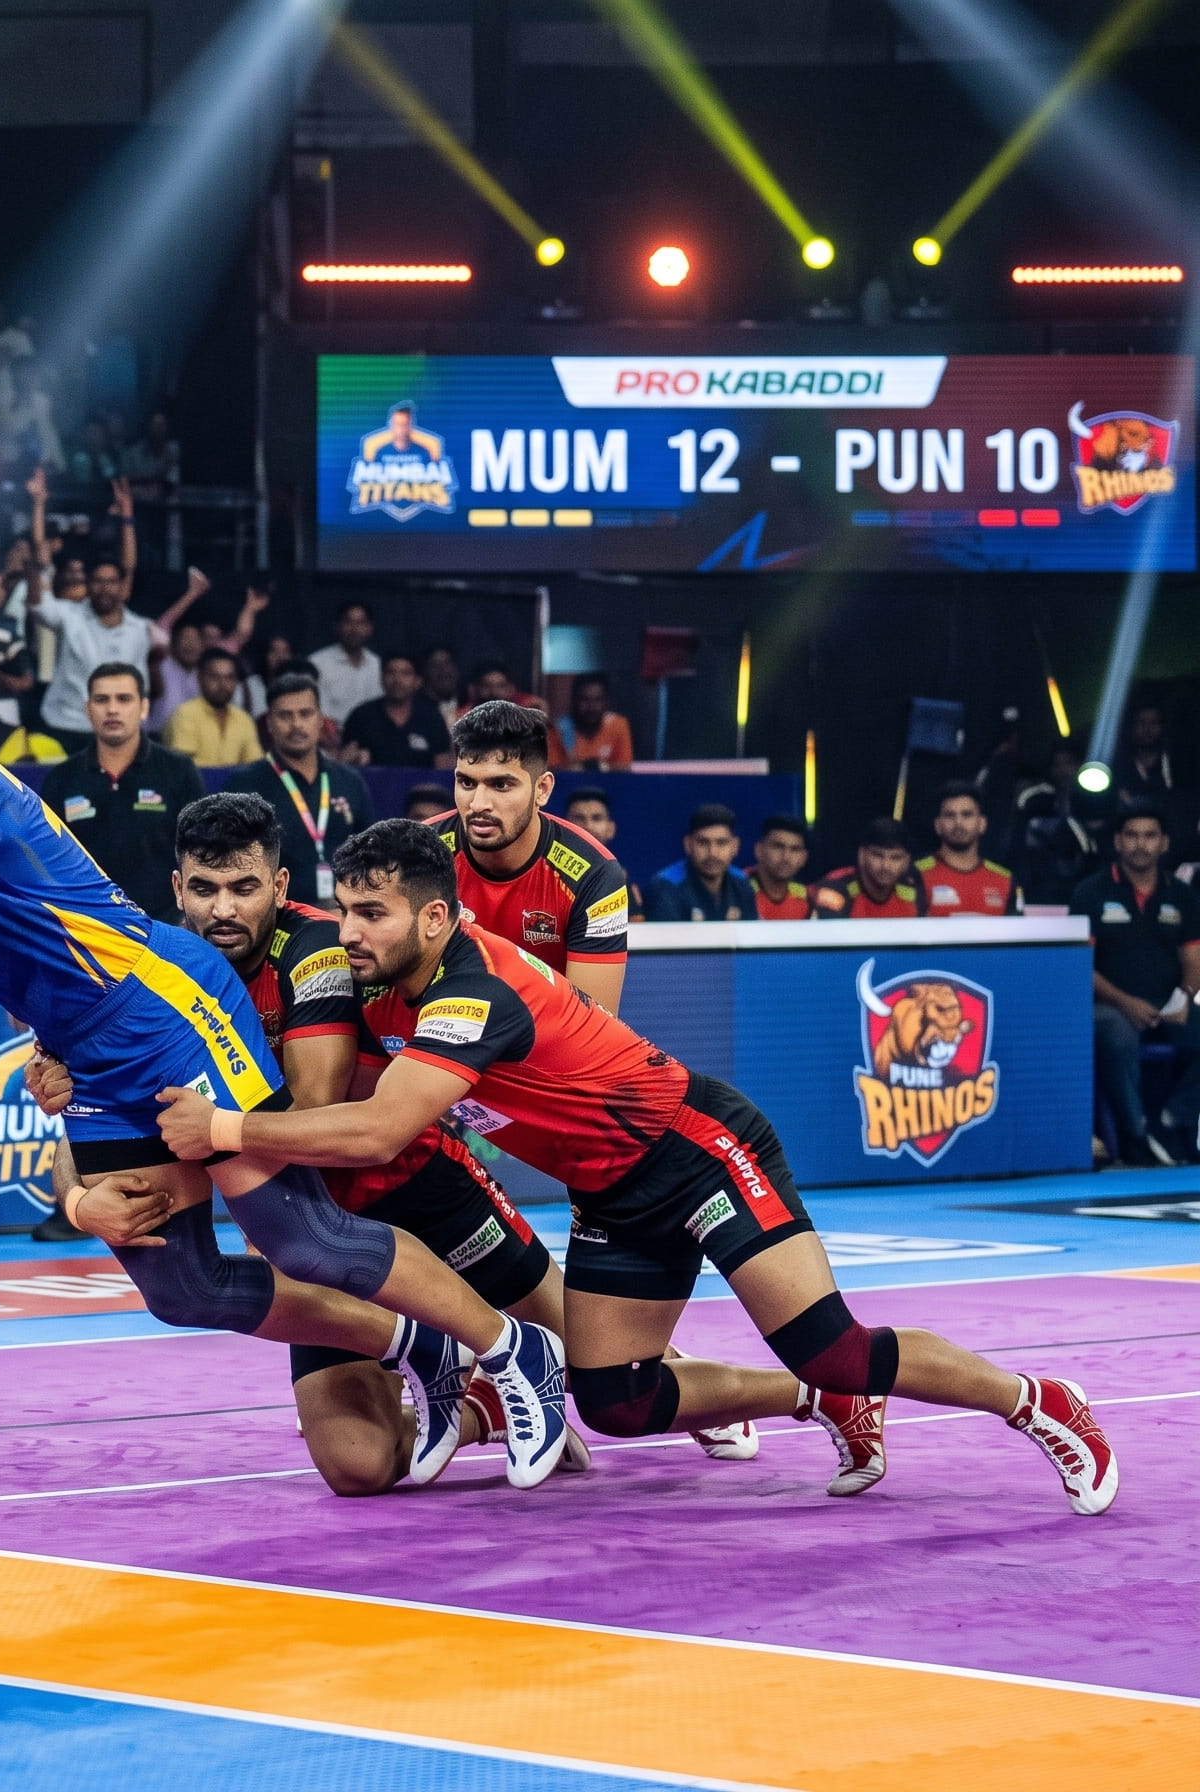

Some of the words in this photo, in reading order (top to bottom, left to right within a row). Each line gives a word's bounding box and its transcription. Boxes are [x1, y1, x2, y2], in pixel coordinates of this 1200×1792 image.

[616, 370, 700, 396] PRO
[704, 370, 885, 395] KABADDI
[470, 428, 628, 493] MUM
[667, 428, 740, 493] 12
[835, 428, 964, 494] PUN
[985, 427, 1059, 494] 10
[858, 1069, 996, 1150] RHINOS
